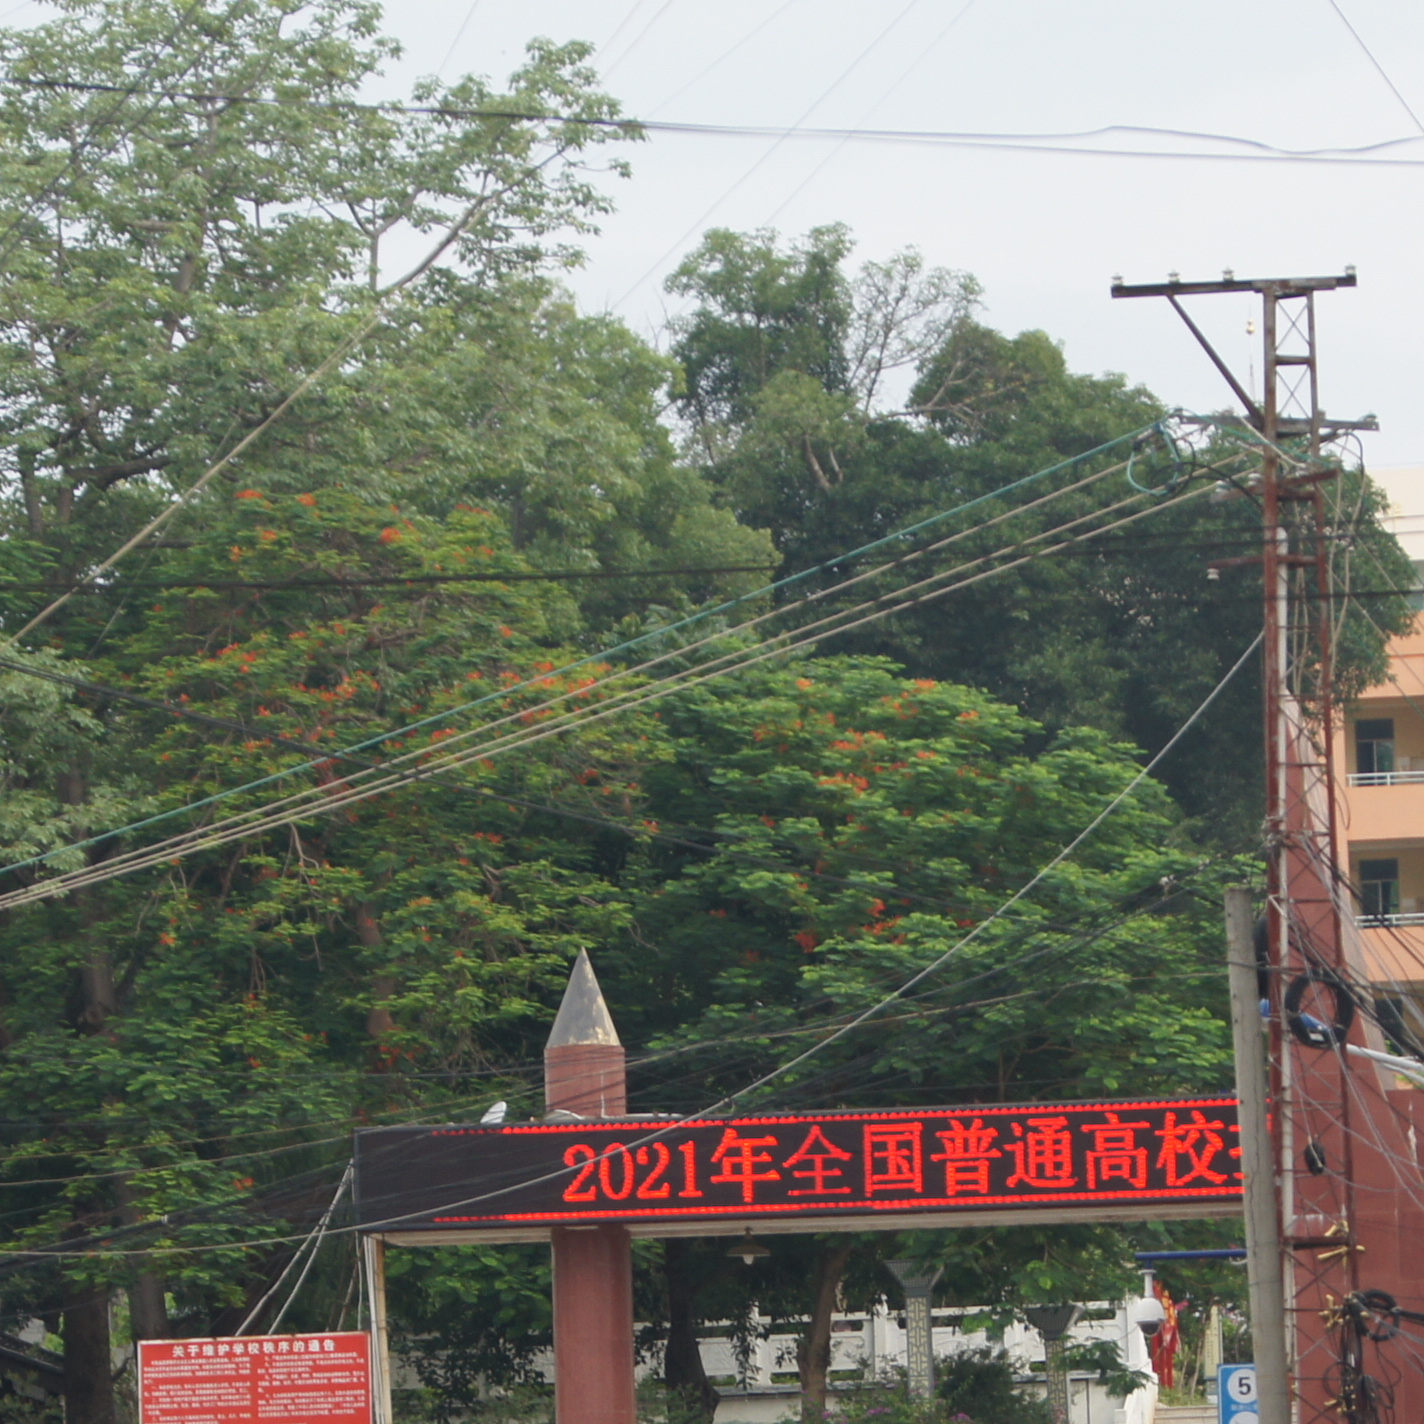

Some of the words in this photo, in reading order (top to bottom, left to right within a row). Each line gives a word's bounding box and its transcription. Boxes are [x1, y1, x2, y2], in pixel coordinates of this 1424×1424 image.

[562, 1110, 1244, 1202] 2021年全国普通高校
[172, 1339, 335, 1357] 关于维护学校秩序的通告
[1238, 1376, 1251, 1396] 5
